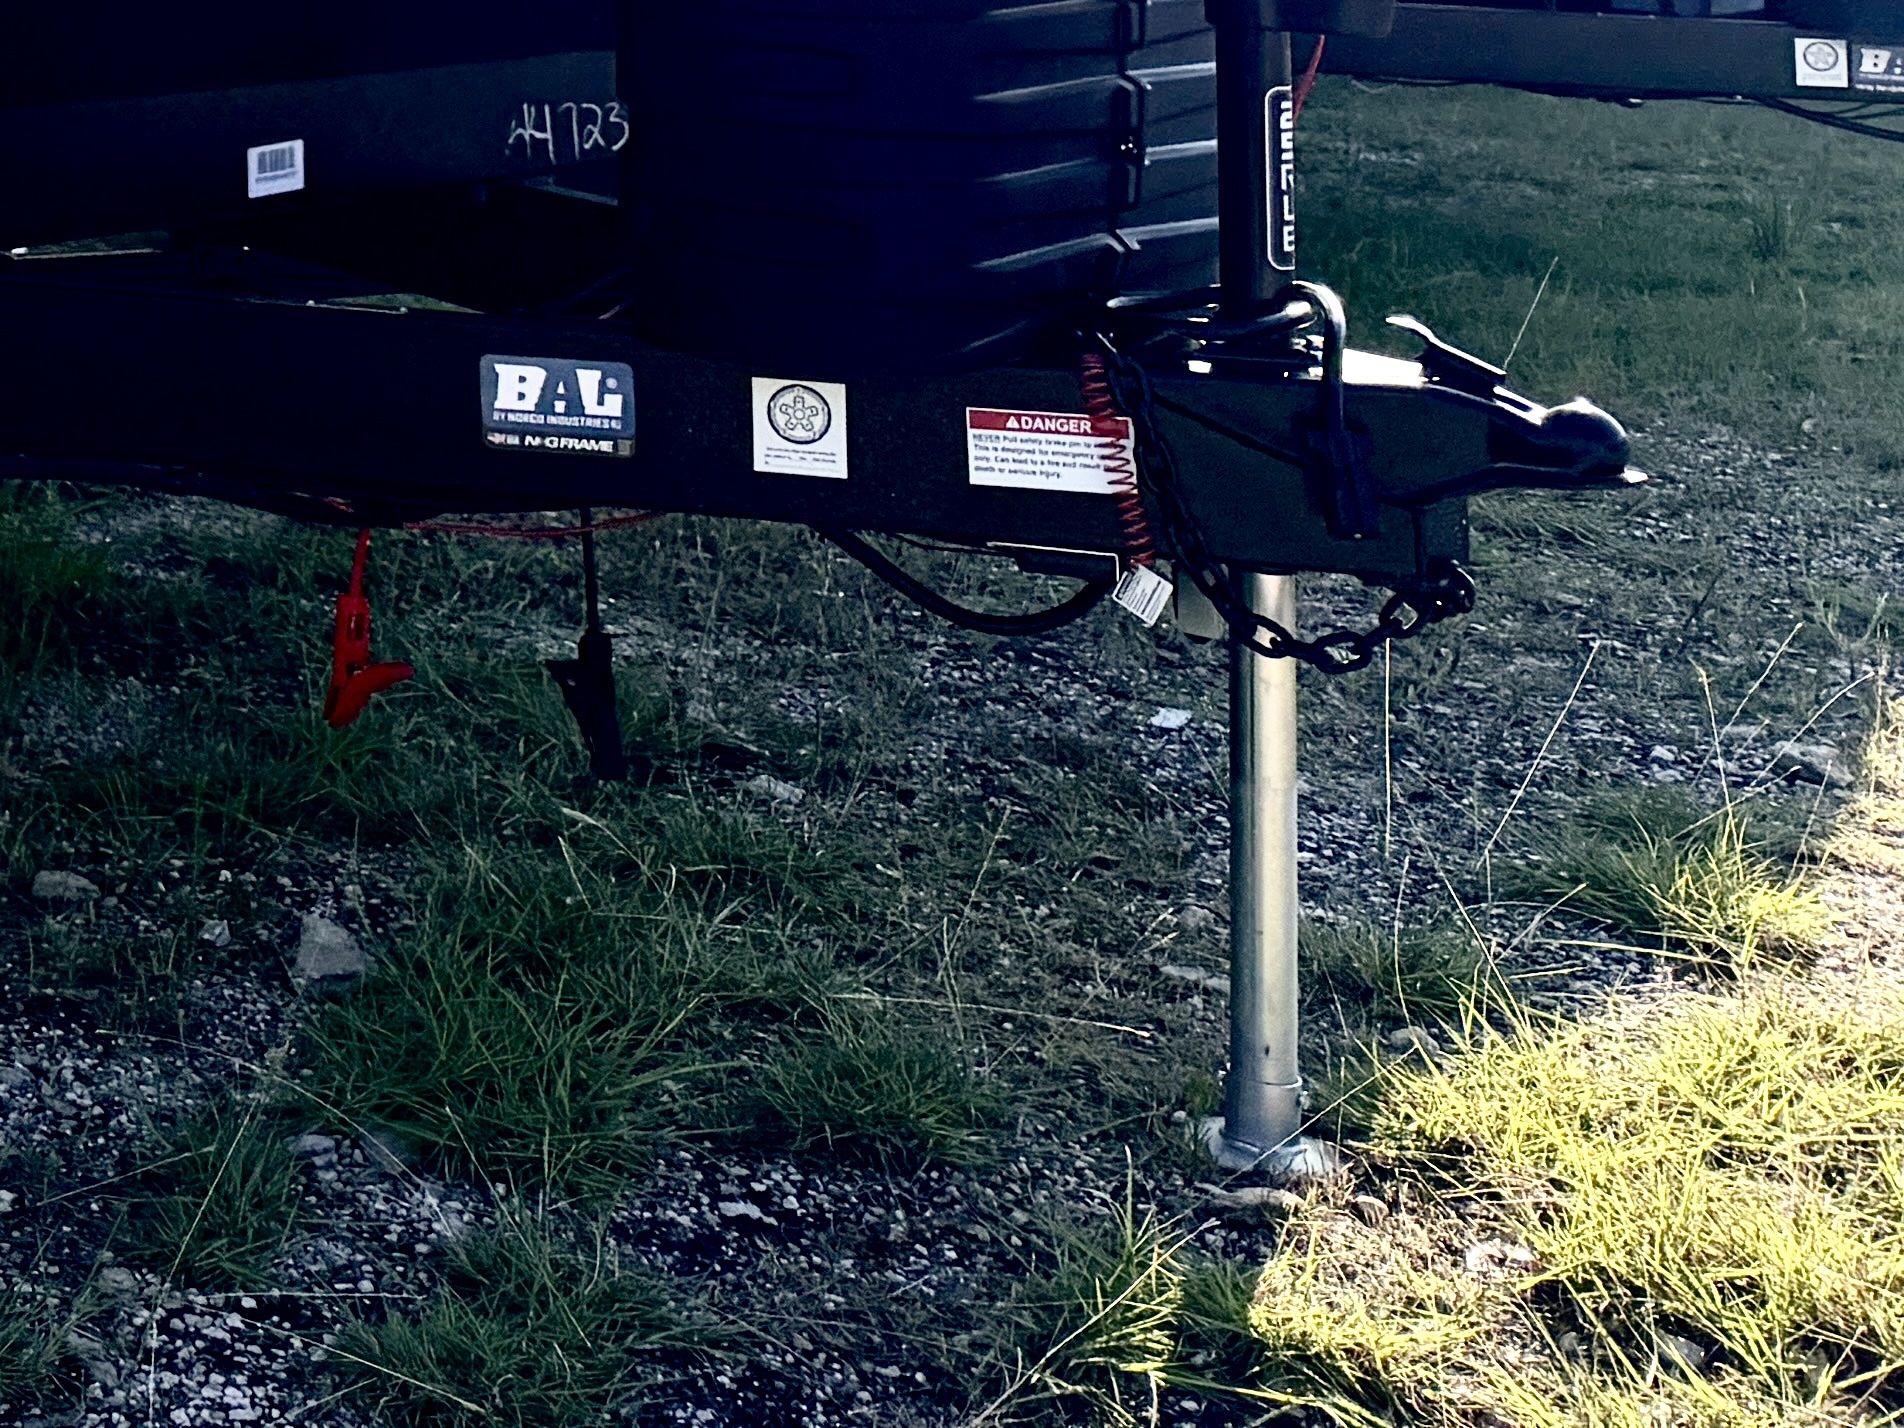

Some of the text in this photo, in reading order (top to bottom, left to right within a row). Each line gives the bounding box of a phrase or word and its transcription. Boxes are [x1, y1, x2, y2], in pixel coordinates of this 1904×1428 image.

[493, 363, 624, 417] BAL
[1020, 416, 1092, 433] DANGER
[559, 437, 614, 452] FRAME
